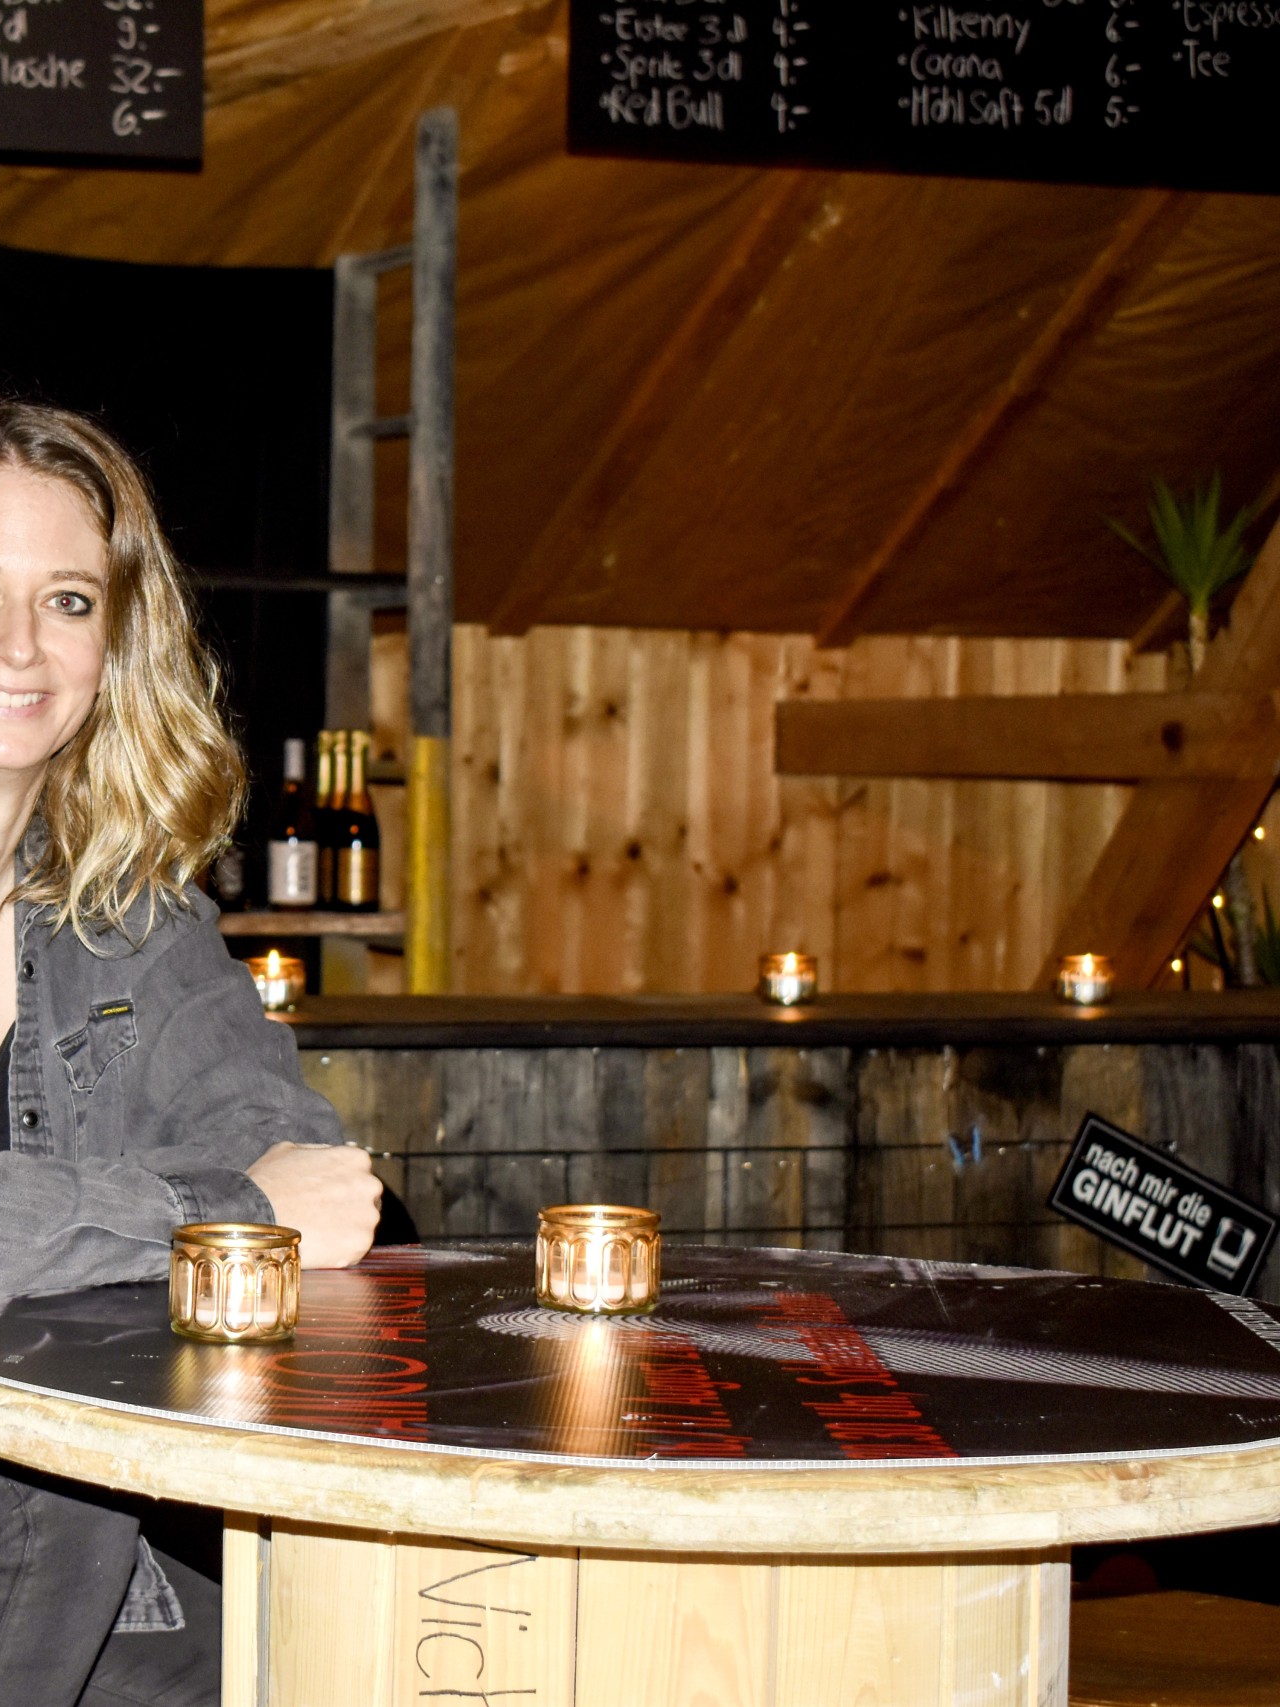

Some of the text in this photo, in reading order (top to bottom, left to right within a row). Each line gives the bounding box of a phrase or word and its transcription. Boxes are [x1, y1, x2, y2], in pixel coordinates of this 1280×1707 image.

[912, 4, 1032, 55] Kilkenny
[1183, 0, 1280, 42] Espress
[610, 43, 685, 90] Sprite
[910, 43, 1004, 82] Corona
[1182, 38, 1232, 80] Tee
[608, 84, 662, 126] Red
[667, 83, 725, 132] Bull
[968, 87, 1025, 130] Saft
[1084, 1142, 1214, 1228] nach mir die
[1072, 1168, 1205, 1259] GINFLUT
[261, 1350, 430, 1443] ANGO
[622, 1361, 742, 1406] August
